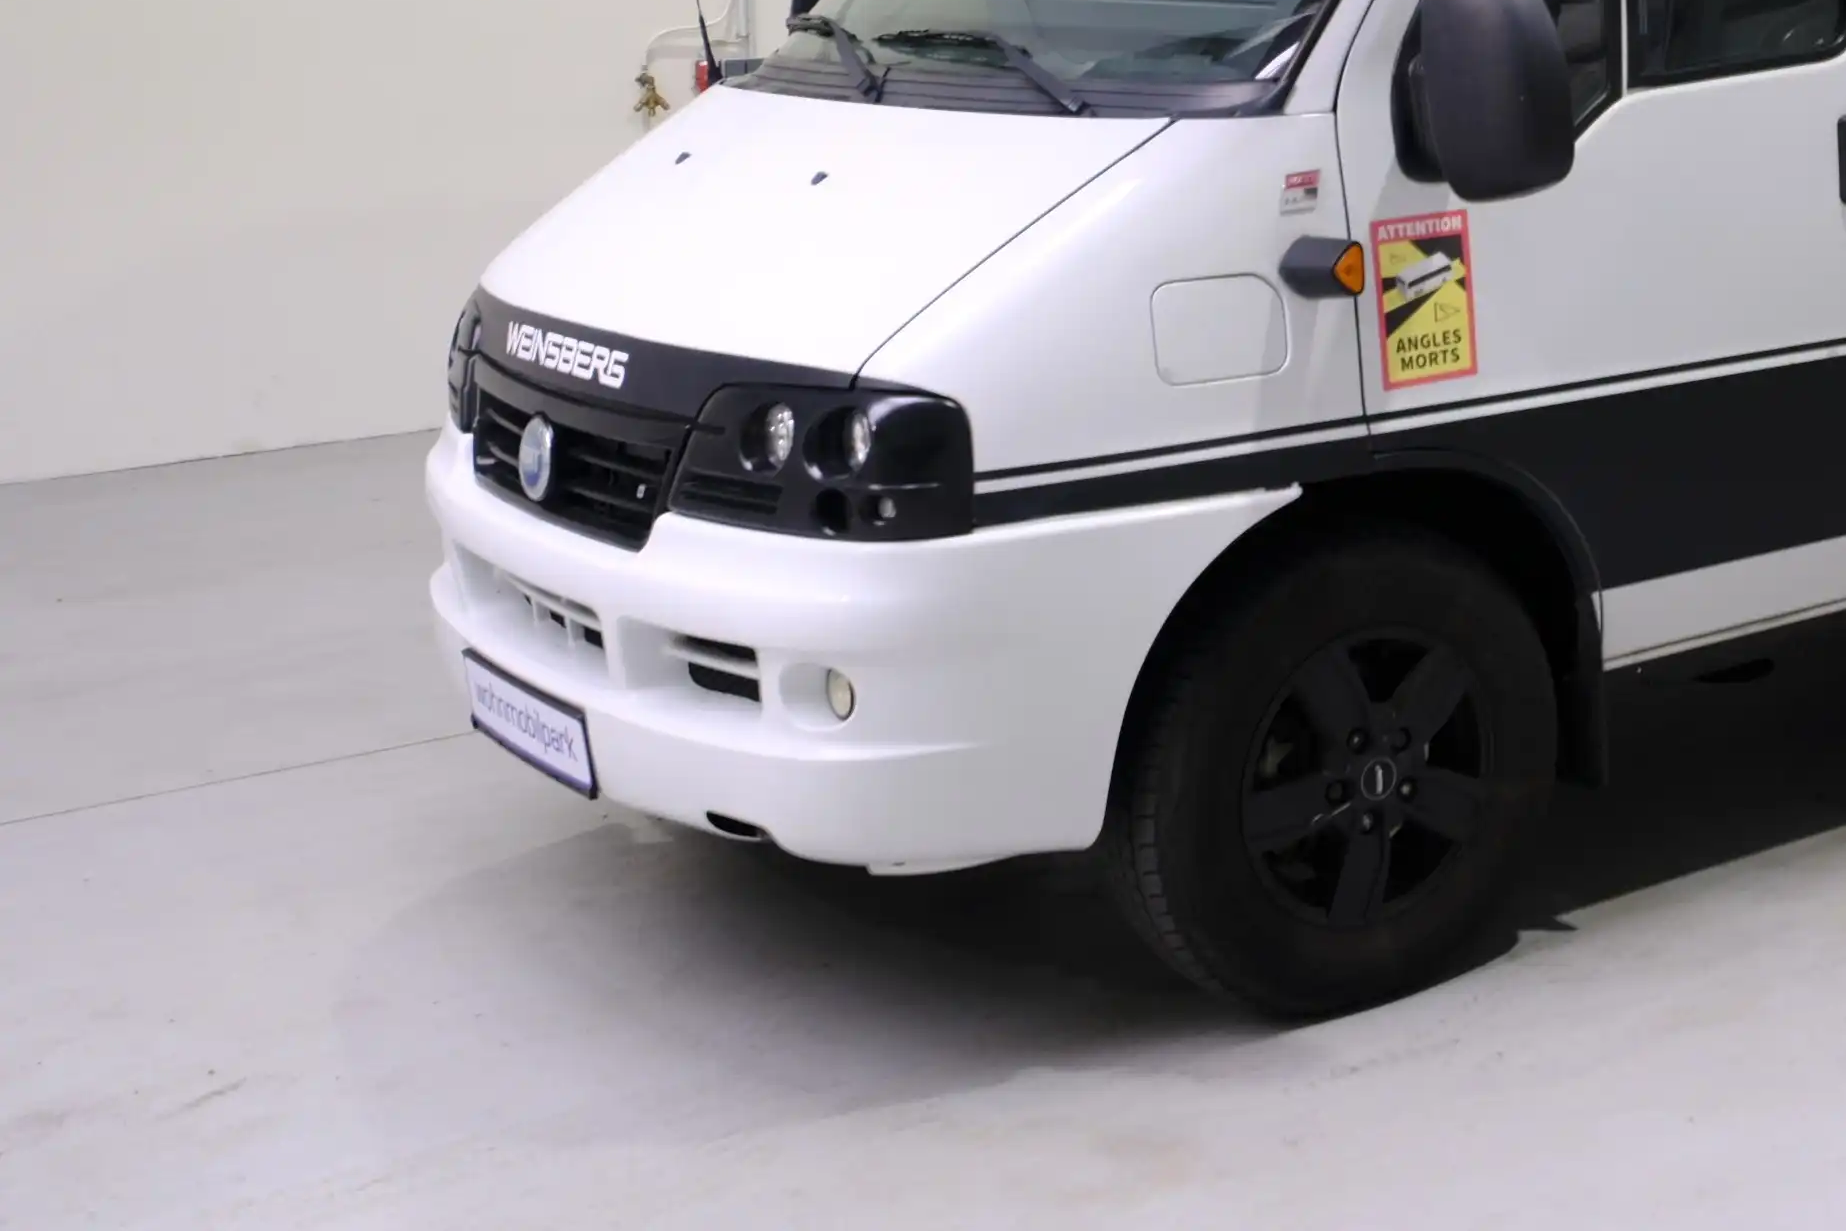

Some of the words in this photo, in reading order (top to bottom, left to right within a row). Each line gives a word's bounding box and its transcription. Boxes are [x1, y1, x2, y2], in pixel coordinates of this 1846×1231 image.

[1377, 216, 1462, 241] ATTENTION
[1396, 329, 1462, 354] ANGLES
[506, 321, 630, 389] WEINSBERG
[1400, 348, 1461, 372] MORTS
